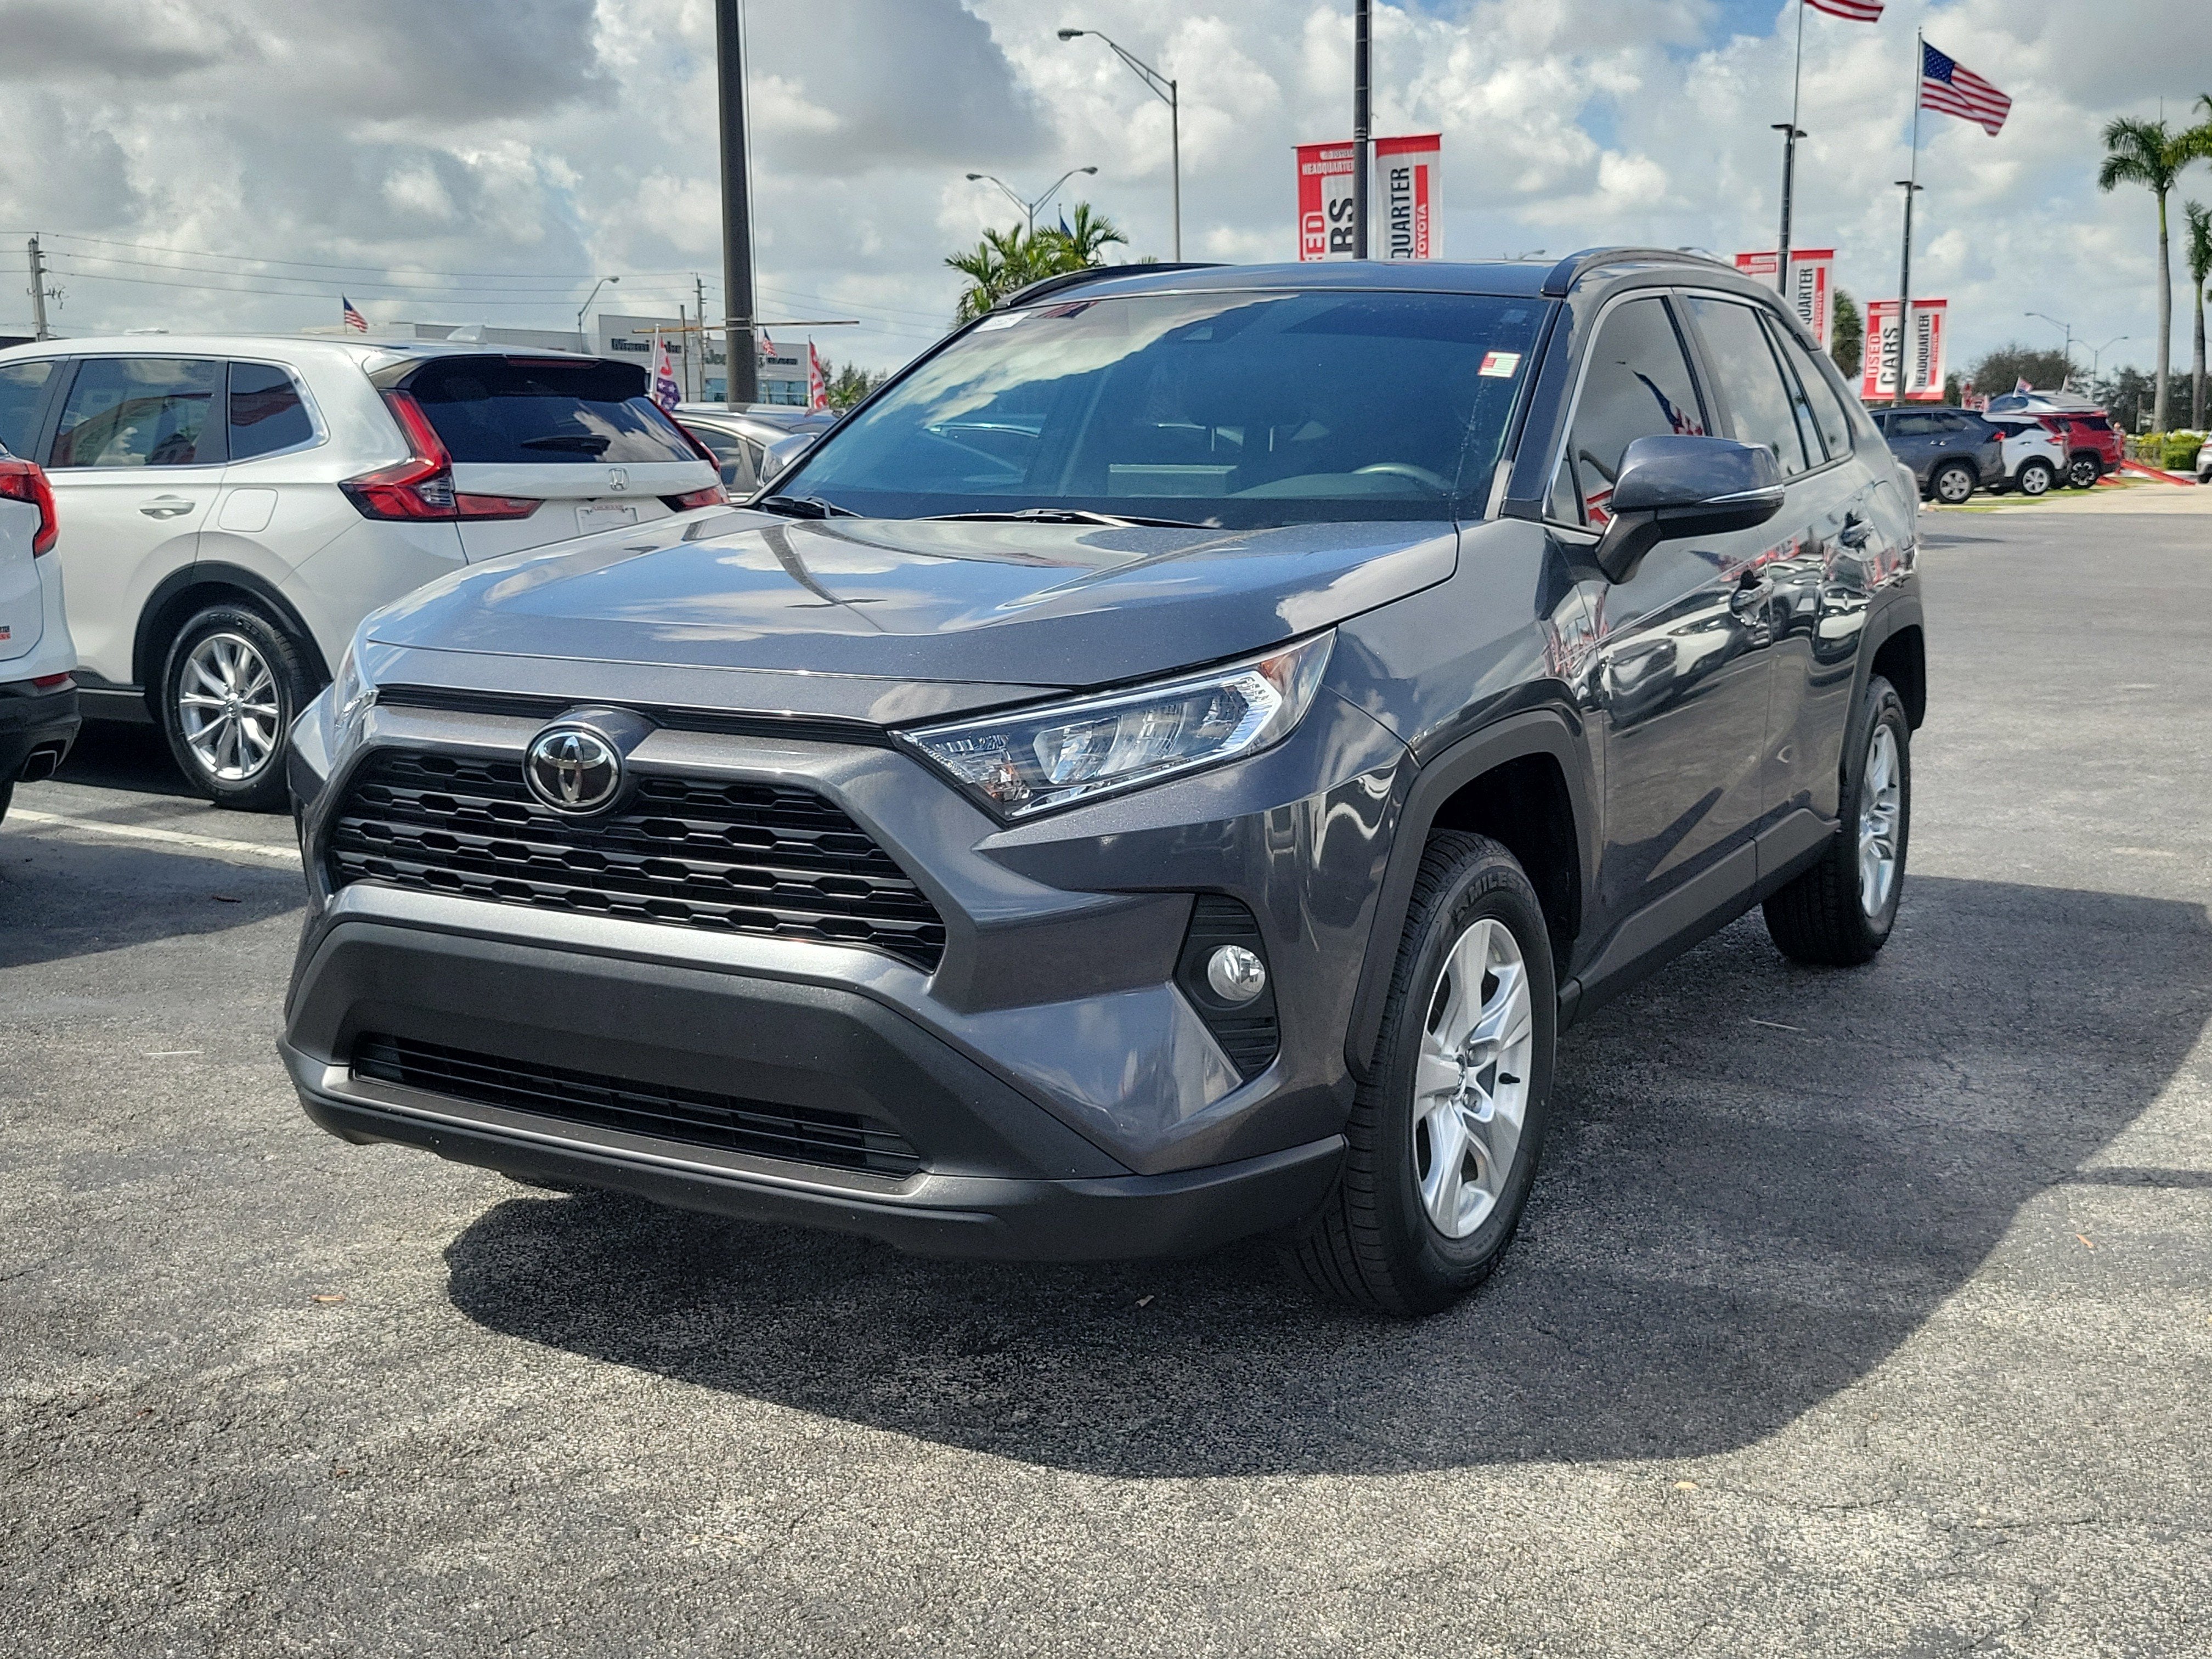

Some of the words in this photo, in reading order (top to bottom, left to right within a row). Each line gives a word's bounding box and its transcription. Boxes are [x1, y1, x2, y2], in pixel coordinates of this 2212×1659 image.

[1306, 215, 1325, 257] ED
[1329, 198, 1353, 253] RS
[1391, 167, 1413, 258] QUARTER
[1797, 268, 1813, 324] QUARTER
[1867, 336, 1880, 374] USED
[1881, 328, 1899, 385] CARS
[1915, 314, 1929, 386] HEADQUARTER
